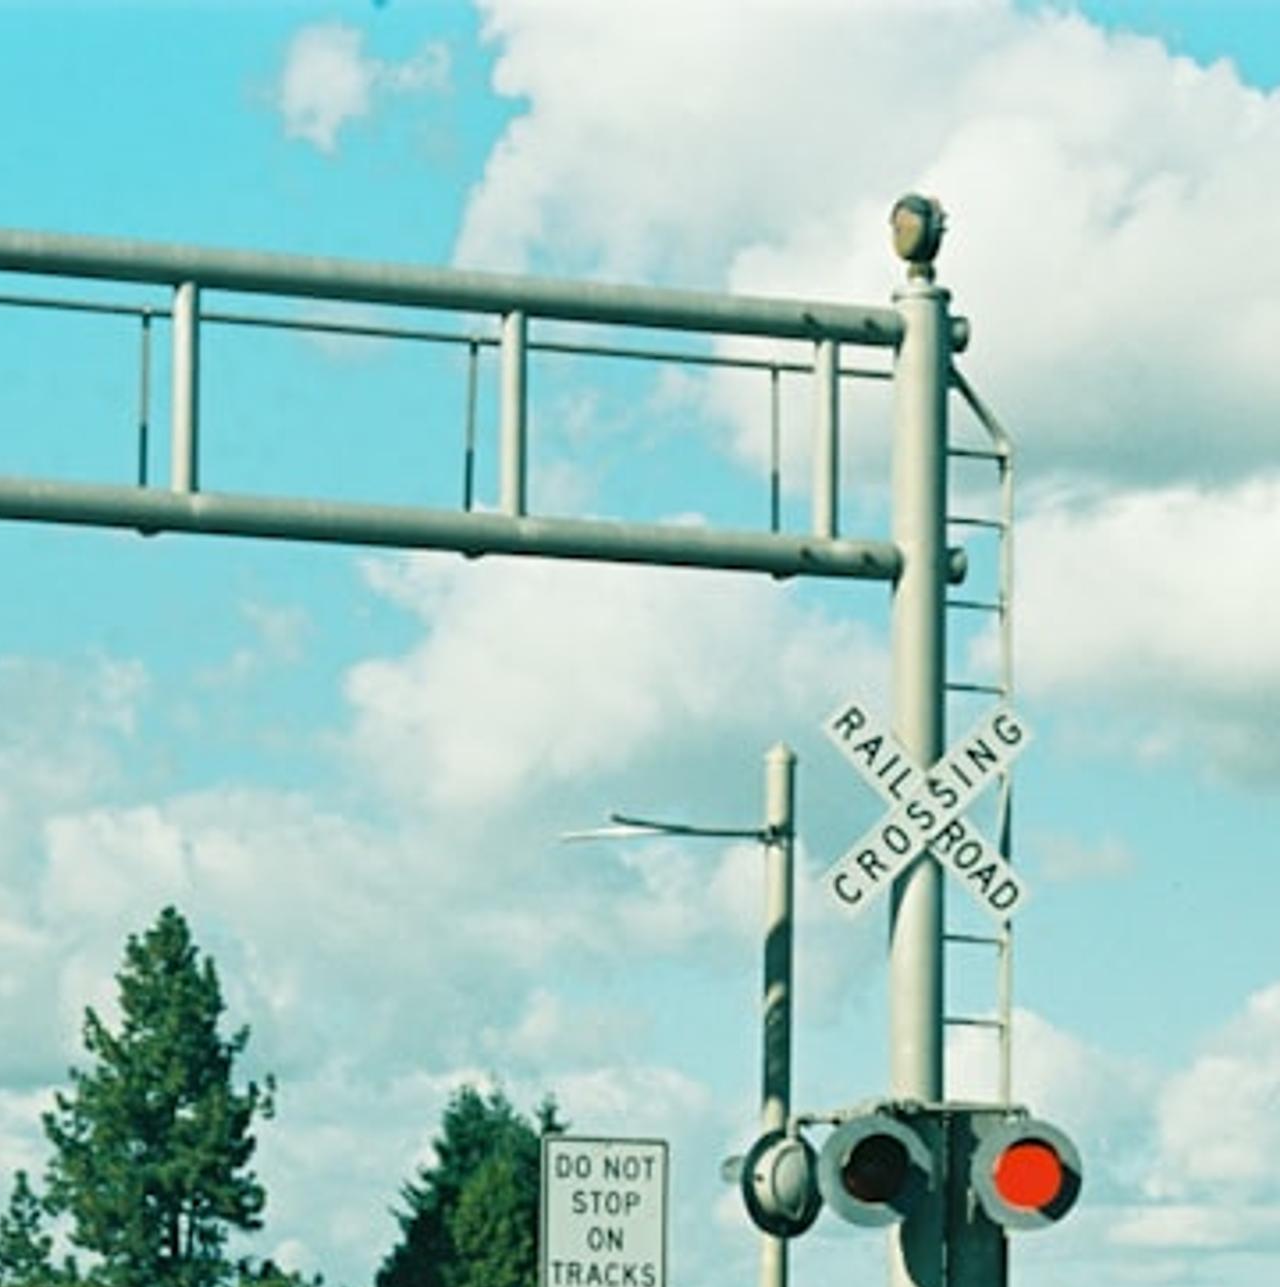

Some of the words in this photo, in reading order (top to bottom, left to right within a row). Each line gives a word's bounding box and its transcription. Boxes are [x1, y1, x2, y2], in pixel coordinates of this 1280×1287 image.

[832, 706, 912, 801] RAIL
[925, 818, 1019, 911] ROAD
[833, 714, 1023, 905] CROSSING
[555, 1153, 591, 1179] DO
[604, 1155, 655, 1181] NOT
[572, 1190, 641, 1215] STOP
[587, 1226, 624, 1251] ON
[552, 1260, 656, 1287] TRACKS
